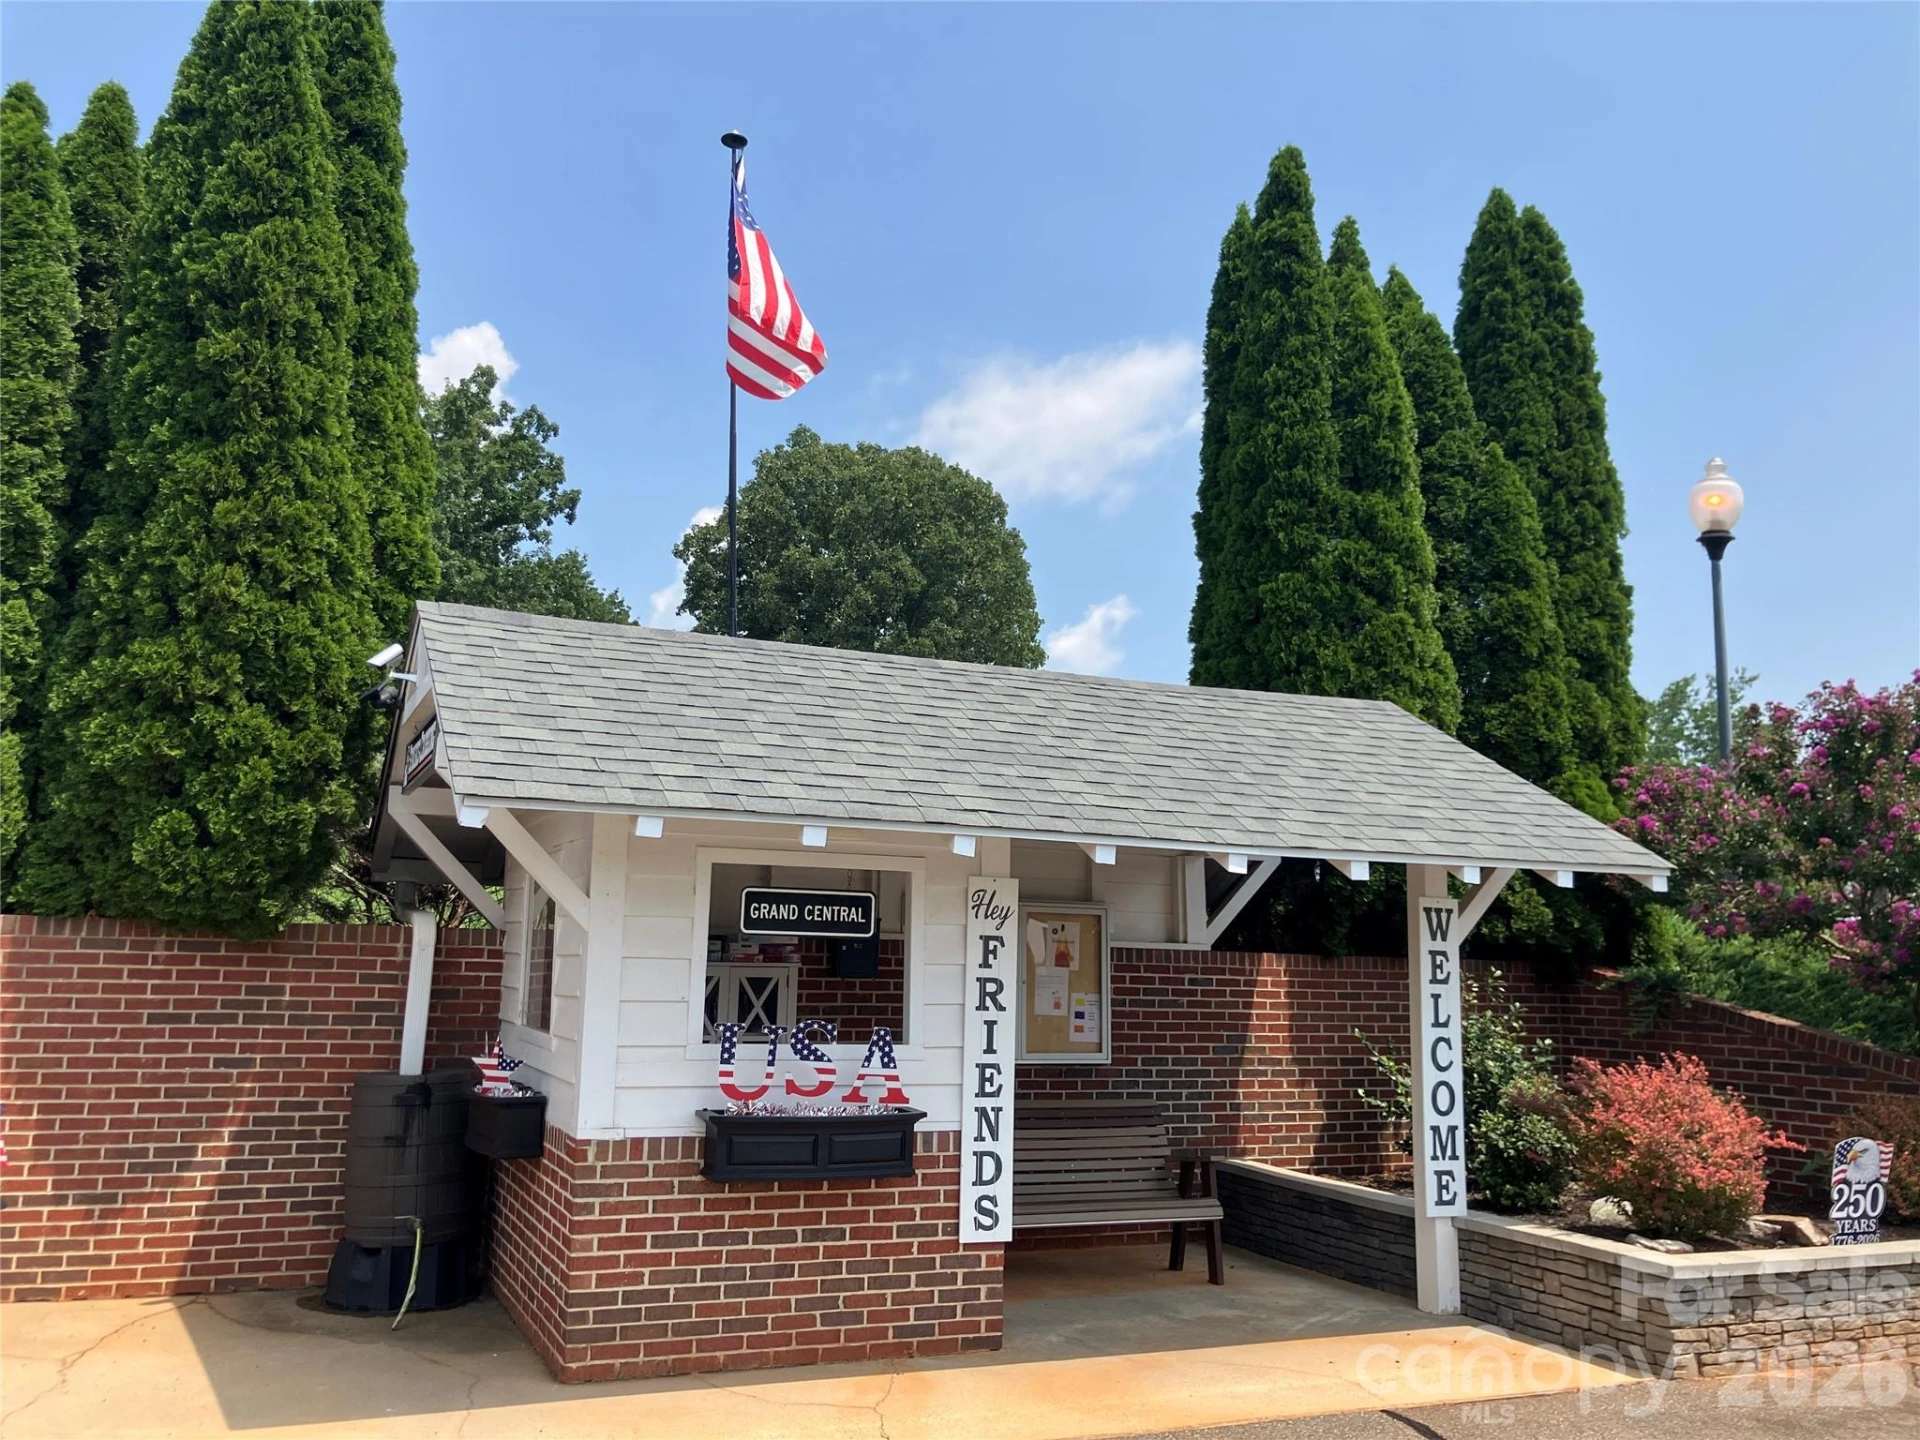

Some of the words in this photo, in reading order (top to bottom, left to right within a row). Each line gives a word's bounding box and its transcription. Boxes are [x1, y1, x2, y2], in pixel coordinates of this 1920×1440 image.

[749, 902, 799, 921] GRAND
[804, 905, 866, 923] CENTRAL
[971, 889, 1016, 931] Hey
[714, 1019, 910, 1104] USA
[1423, 906, 1460, 1207] WELCOME
[971, 935, 1007, 1232] FRIENDS
[1831, 1183, 1884, 1218] 250
[1837, 1219, 1876, 1234] YEARS
